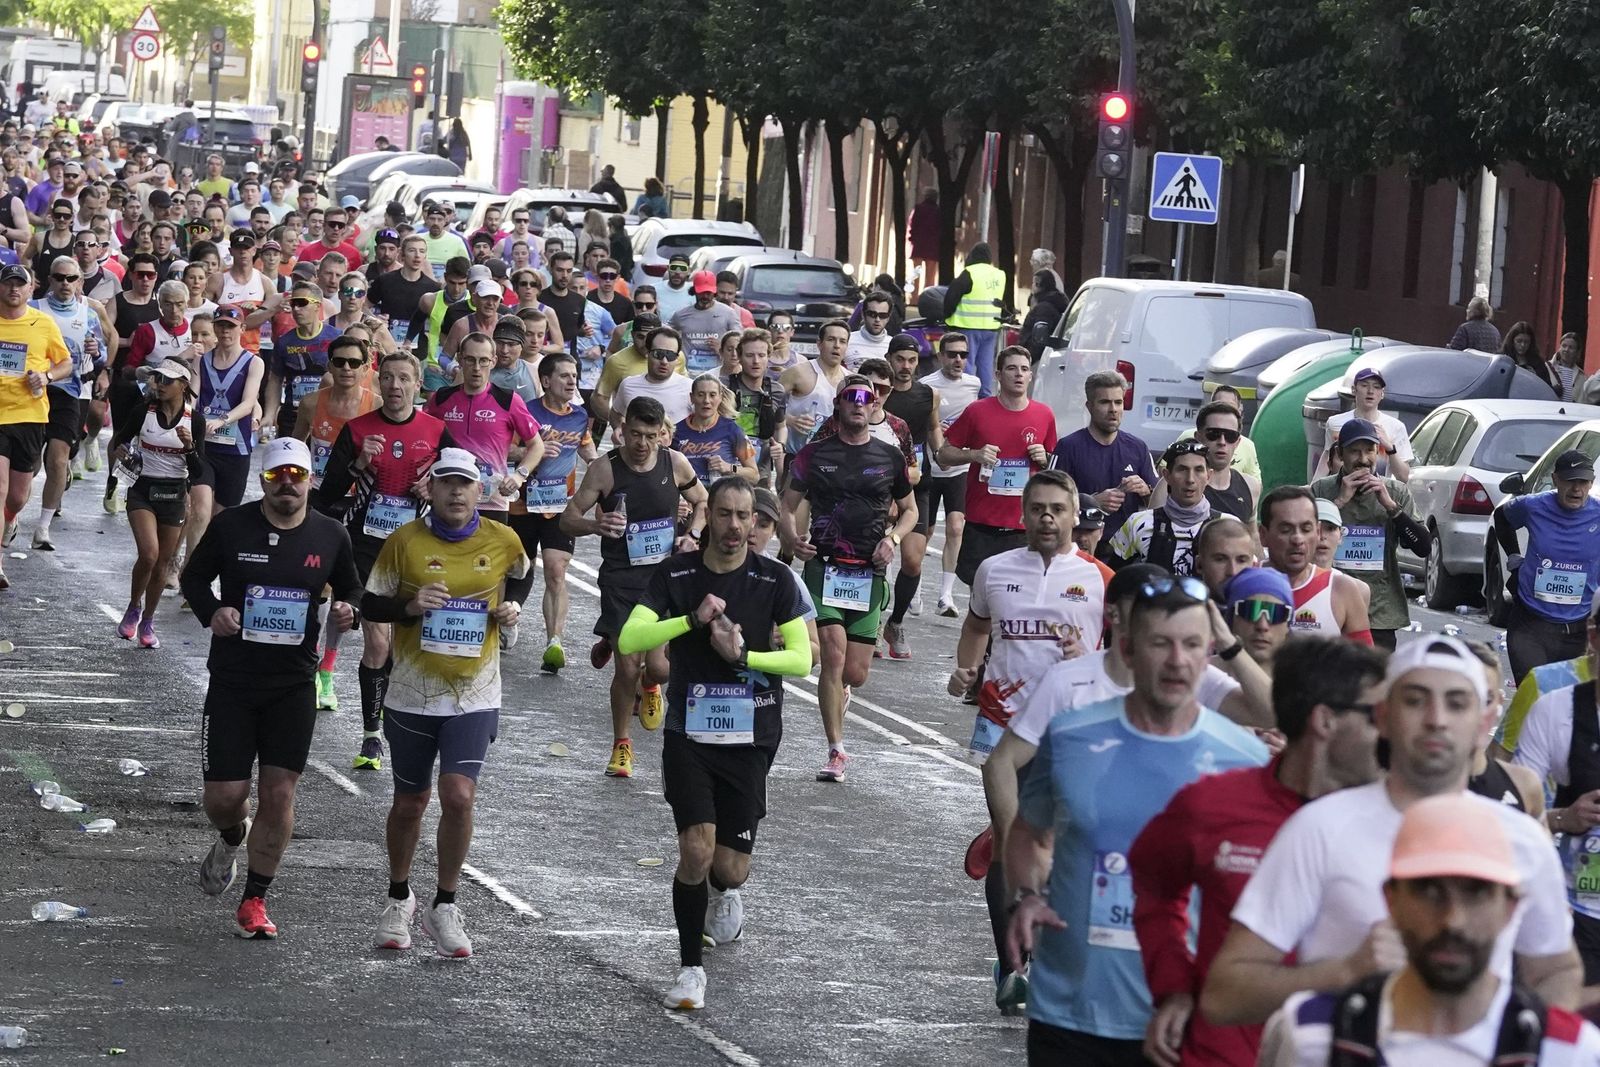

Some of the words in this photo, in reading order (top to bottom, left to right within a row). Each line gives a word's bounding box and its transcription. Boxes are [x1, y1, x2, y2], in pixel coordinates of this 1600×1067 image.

[138, 42, 155, 52] 30
[2, 343, 24, 351] ZURICH
[1154, 407, 1181, 418] 9177
[541, 478, 563, 486] ZURICH
[1004, 479, 1014, 487] PL
[385, 497, 412, 507] ZURICH
[641, 520, 669, 530] ZURICH
[644, 543, 662, 555] FER
[1345, 549, 1373, 560] MANU
[1554, 562, 1583, 571] ZURICH
[1545, 582, 1574, 595] CHRIS
[268, 589, 304, 600] ZURICH
[833, 588, 860, 600] BITOR
[446, 600, 481, 610] ZURICH
[268, 605, 287, 616] 7058
[253, 615, 298, 632] HASSEL
[446, 617, 465, 626] 6874
[422, 627, 436, 639] EL
[439, 629, 485, 643] CUERPO
[710, 687, 746, 696] ZURICH
[710, 705, 731, 714] 9340
[706, 717, 734, 729] TONI
